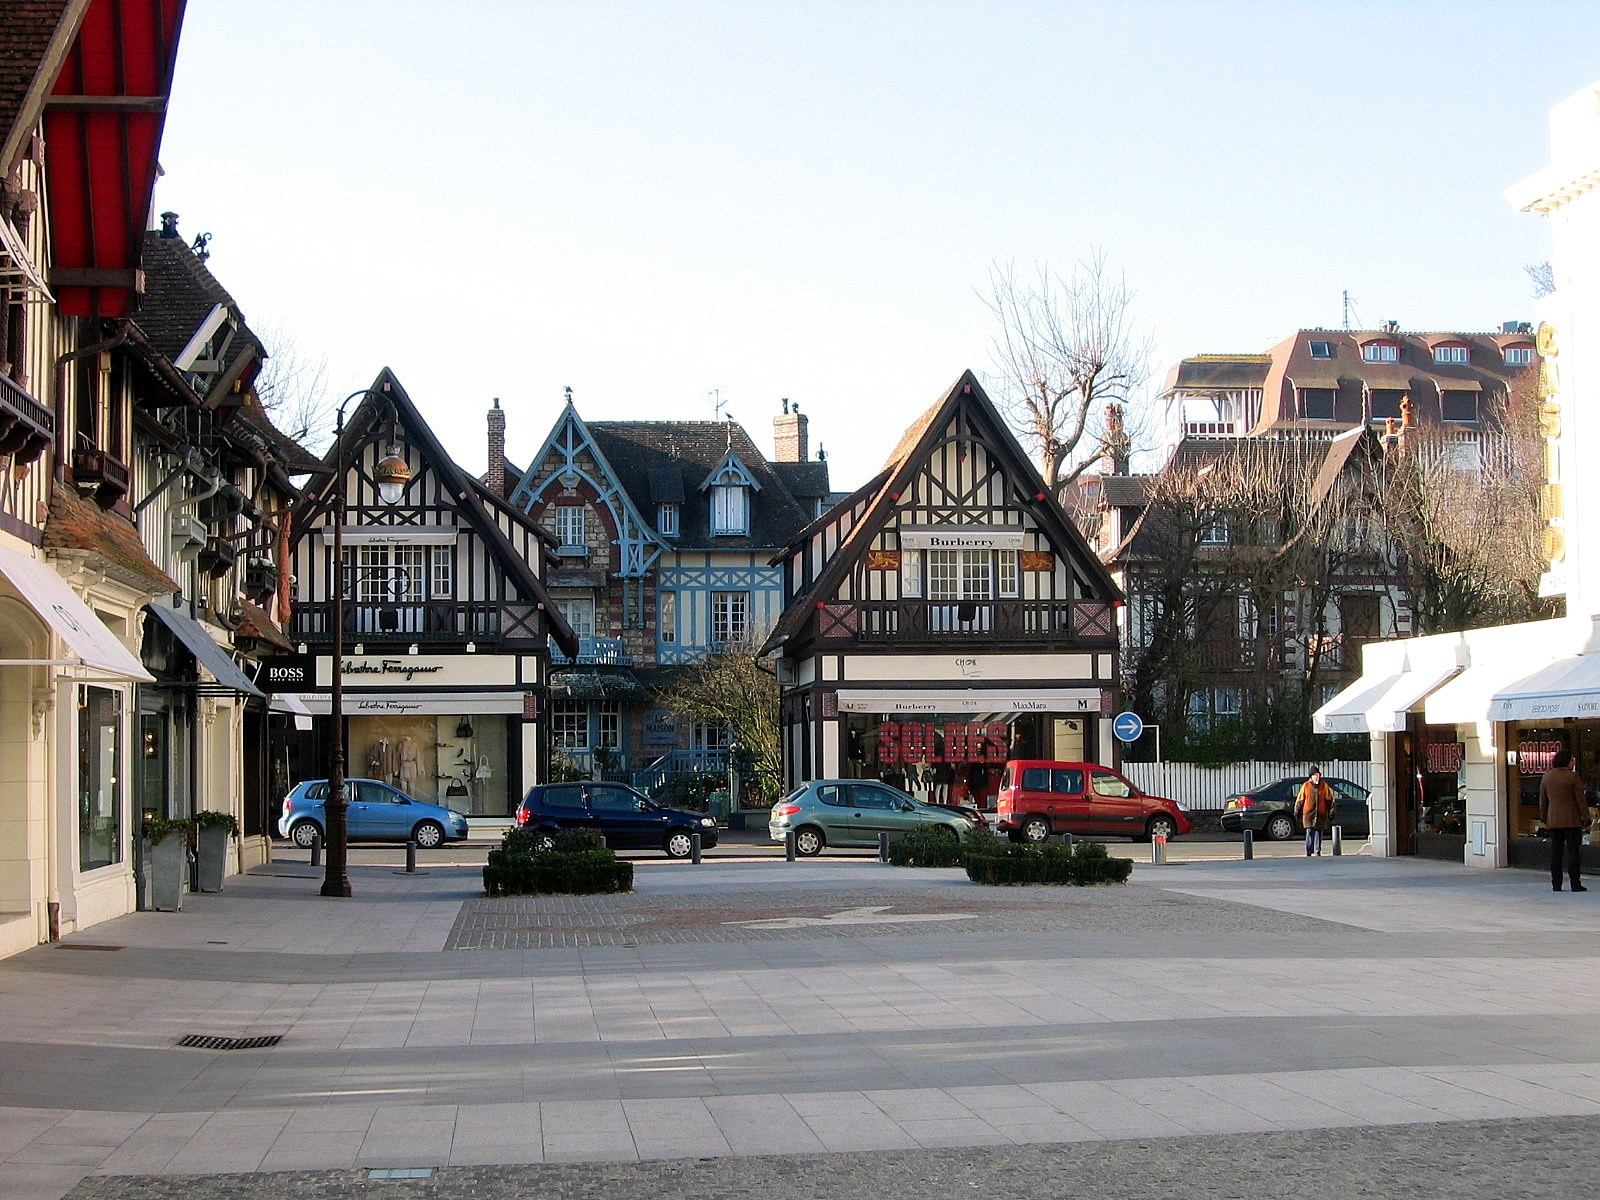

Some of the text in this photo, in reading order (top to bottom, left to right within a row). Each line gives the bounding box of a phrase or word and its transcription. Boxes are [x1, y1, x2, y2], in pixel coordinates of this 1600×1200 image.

[930, 537, 995, 548] Burberry
[269, 667, 304, 678] BOSS
[341, 659, 444, 681] alvatore Ferragamo
[895, 703, 936, 711] Burberry
[1012, 701, 1047, 709] MaxMara
[1078, 699, 1088, 709] M
[645, 723, 675, 733] MAISON
[878, 721, 1008, 764] SOLDES
[1427, 743, 1463, 773] SOLDES
